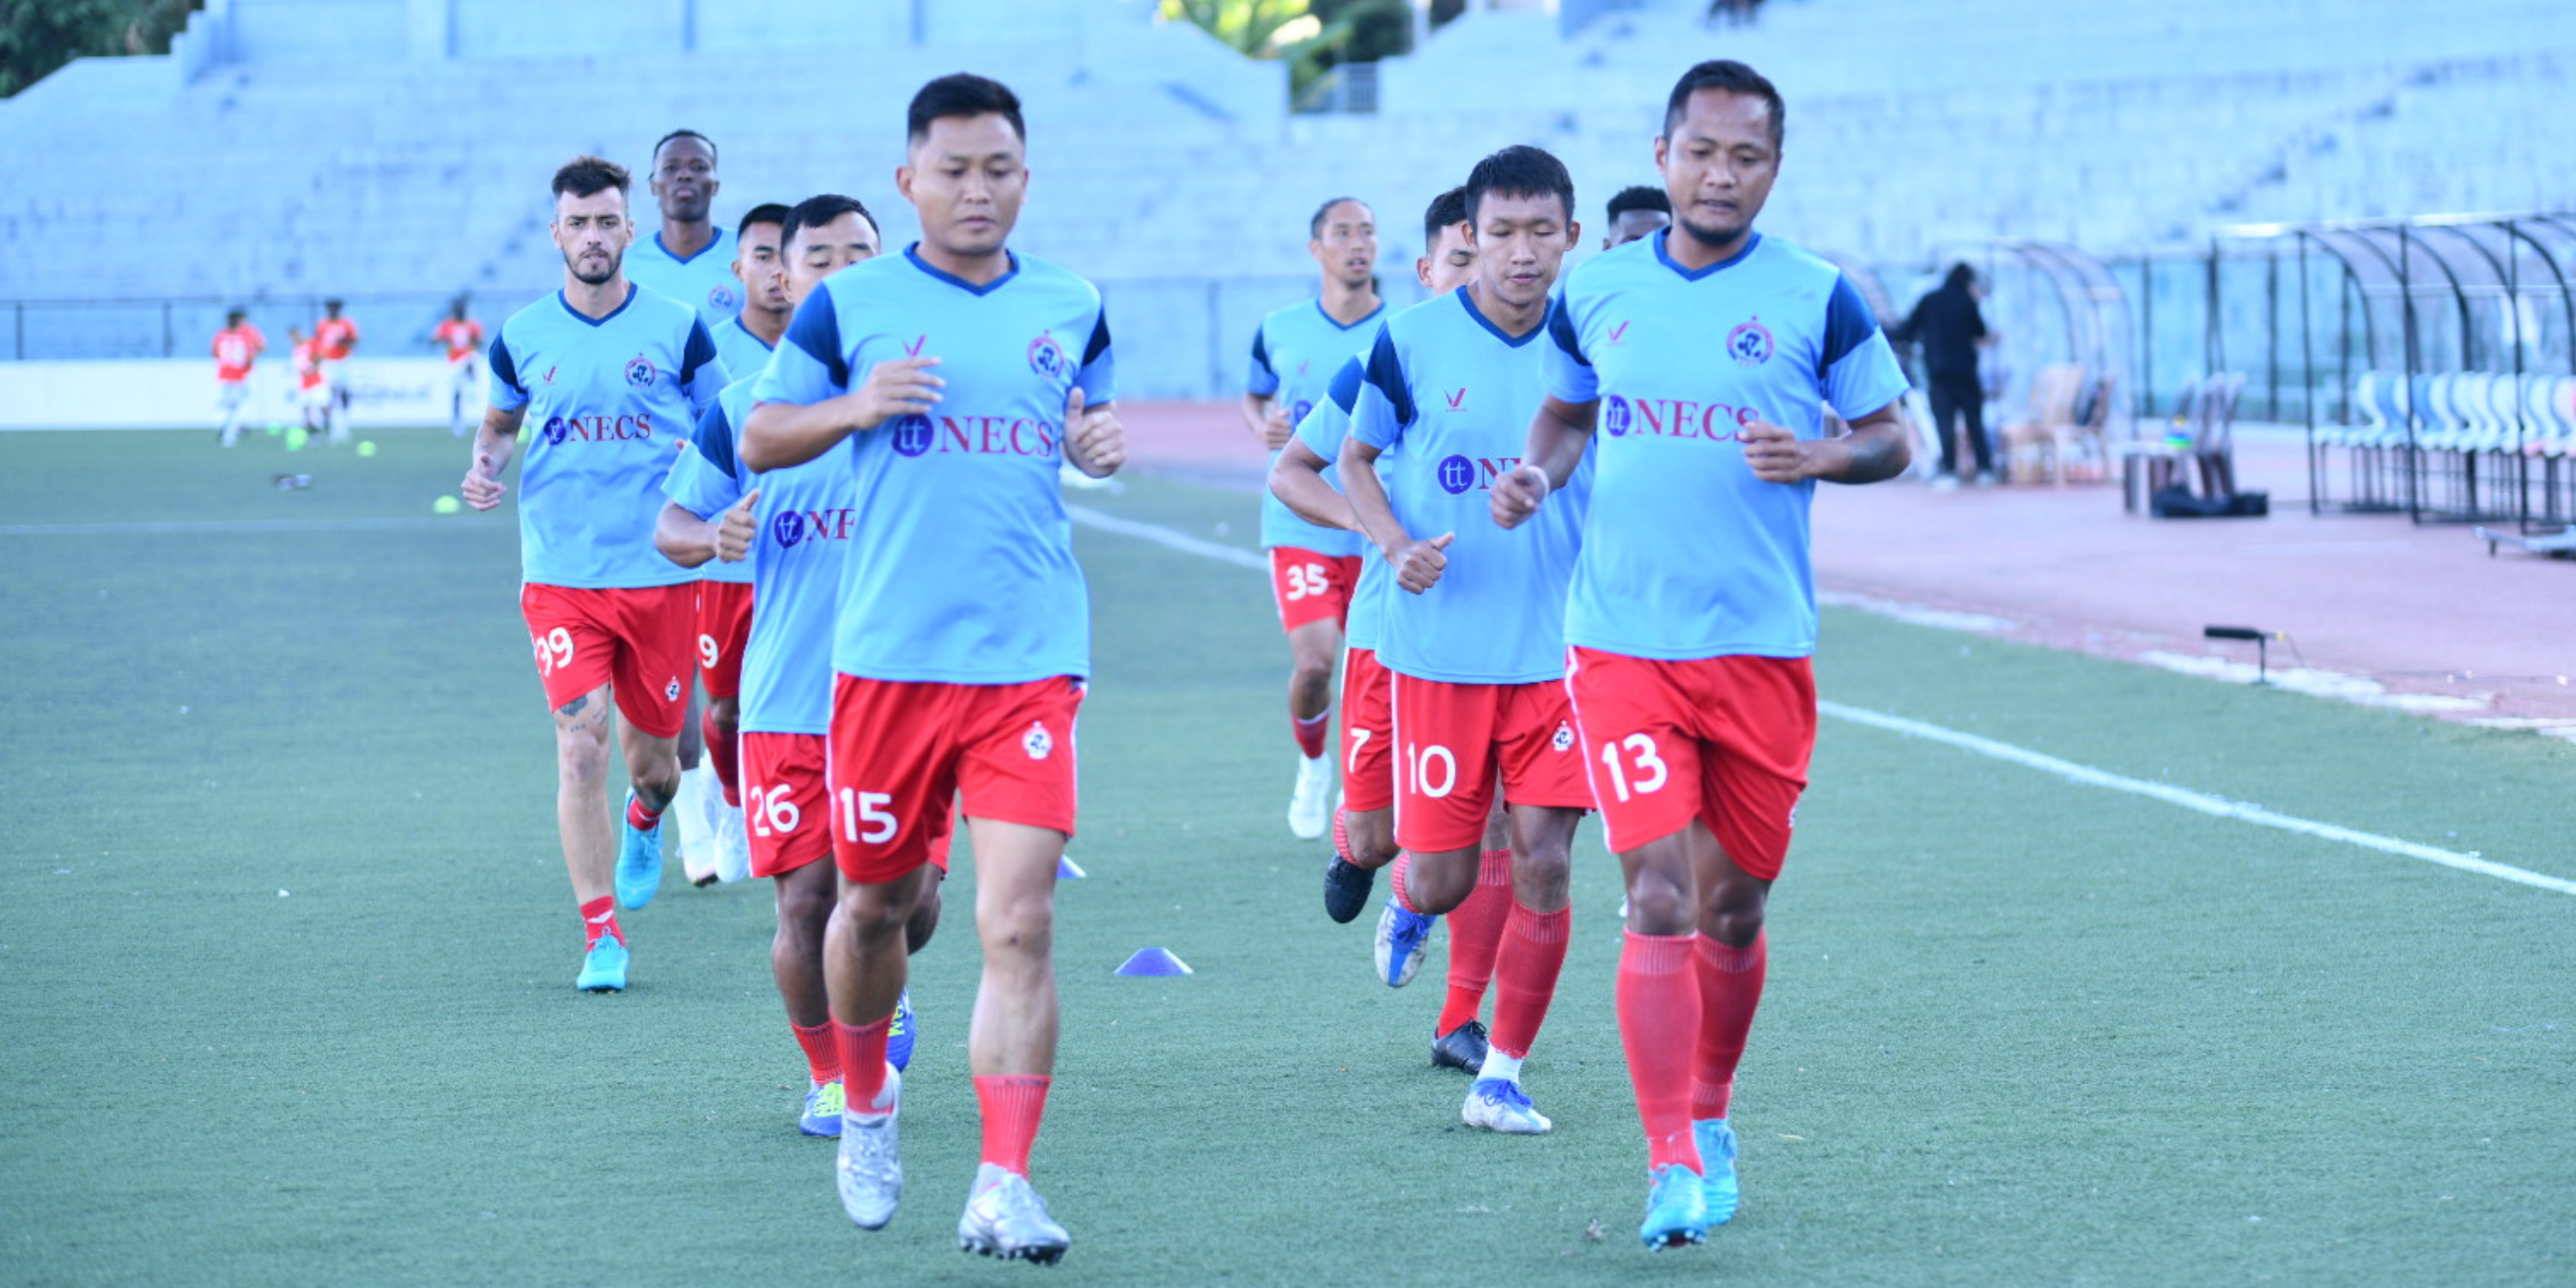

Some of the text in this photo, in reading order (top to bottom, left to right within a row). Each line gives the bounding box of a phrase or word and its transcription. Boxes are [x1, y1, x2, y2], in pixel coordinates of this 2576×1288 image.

[568, 413, 652, 442] NECS
[937, 416, 1054, 458] NECS
[1634, 398, 1760, 444] NECS
[1477, 457, 1521, 489] N
[1286, 563, 1329, 601] 35
[534, 627, 574, 677] 99
[698, 634, 720, 668] 9
[1350, 727, 1371, 773] 7
[1407, 742, 1457, 798] 10
[1601, 732, 1668, 802] 13
[750, 783, 800, 837] 26
[839, 786, 899, 844] 15
